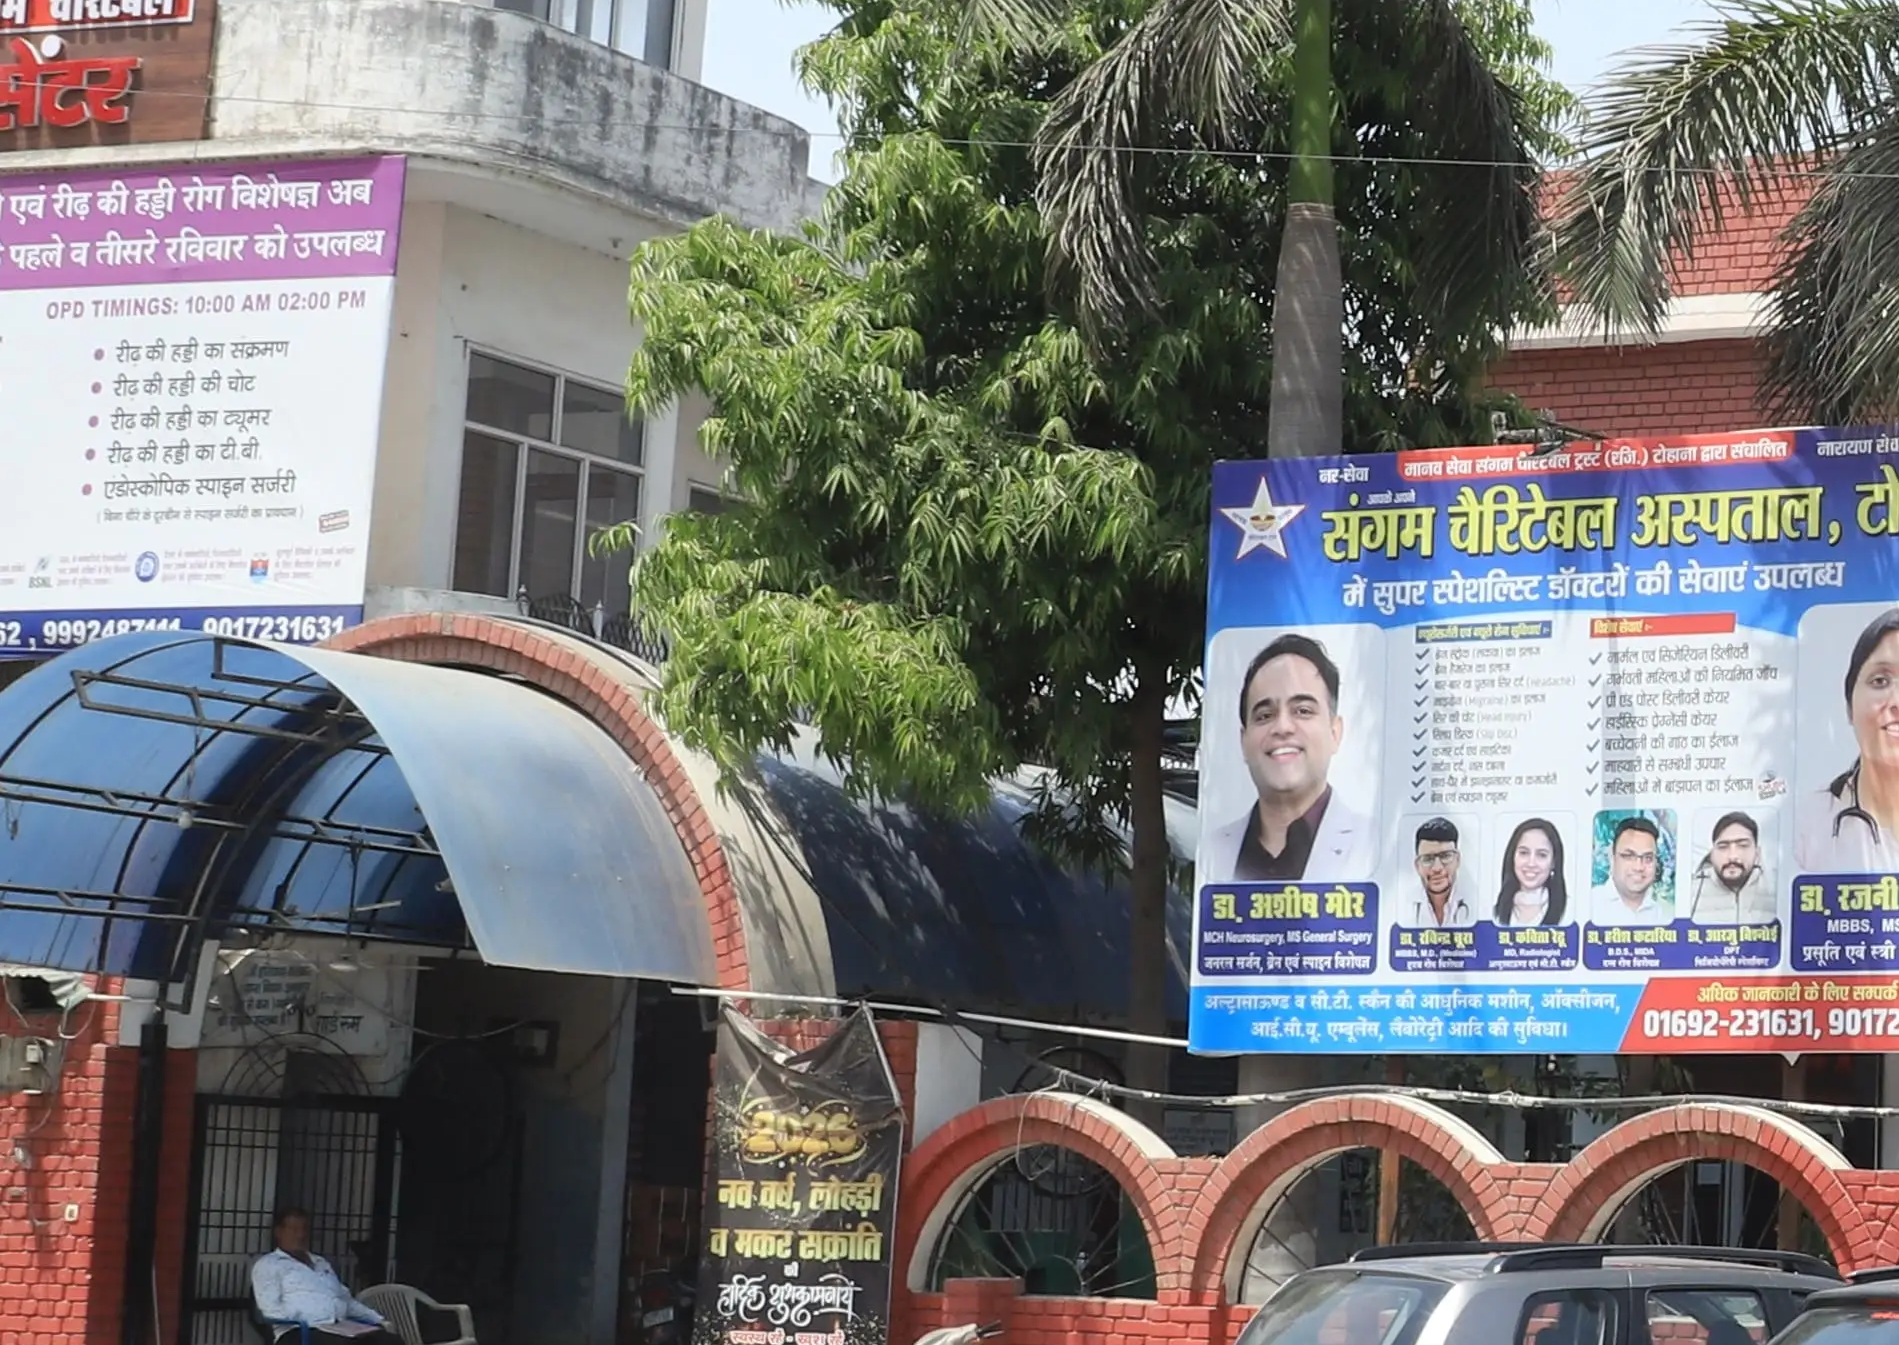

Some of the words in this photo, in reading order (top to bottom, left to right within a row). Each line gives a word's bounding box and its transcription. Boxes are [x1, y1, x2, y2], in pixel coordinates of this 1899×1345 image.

[10, 185, 45, 225] एवं
[52, 178, 90, 220] रीढ़
[97, 180, 127, 216] की
[135, 178, 176, 218] हड्डी
[183, 176, 225, 212] रोग
[231, 173, 320, 208] विशेषज्ञ
[327, 178, 373, 205] अब
[10, 234, 62, 270] पहले
[71, 240, 89, 266] व
[96, 229, 158, 265] तीसरे
[165, 227, 248, 263] रविवार
[254, 225, 289, 258] को
[293, 229, 385, 257] उपलब्ध
[46, 301, 84, 319] OPD
[92, 297, 178, 317] TIMINGS:
[185, 295, 234, 314] 10:00
[241, 294, 270, 312] AM
[278, 292, 330, 310] 02:00
[338, 291, 366, 308] PM
[143, 373, 162, 396] की
[201, 371, 221, 393] की
[228, 369, 256, 393] चोट
[1319, 464, 1369, 484] नर-सेवा
[1321, 493, 1437, 561] संगम
[1448, 483, 1618, 556] चैरिटेबल
[1343, 575, 1368, 609] में
[1372, 579, 1427, 616] सुपर
[1547, 563, 1630, 599] डॉक्टरों
[1635, 561, 1671, 596] की
[1679, 559, 1748, 594] सेवाएं
[1753, 561, 1845, 592] उपलब्ध
[203, 615, 344, 642] 9017231631
[1212, 891, 1243, 923] डा.
[1251, 885, 1318, 921] अशीष
[1325, 887, 1365, 920] मोर
[1800, 882, 1831, 916] डा.
[1838, 876, 1898, 913] रजनी
[1827, 918, 1875, 936] MBBS,
[1643, 1010, 1822, 1040] 01692-231631,
[746, 1110, 858, 1154] 2026
[718, 1180, 754, 1209] नव
[809, 1172, 884, 1217] लोहड़ी
[710, 1228, 730, 1258] व
[734, 1229, 794, 1258] मकर
